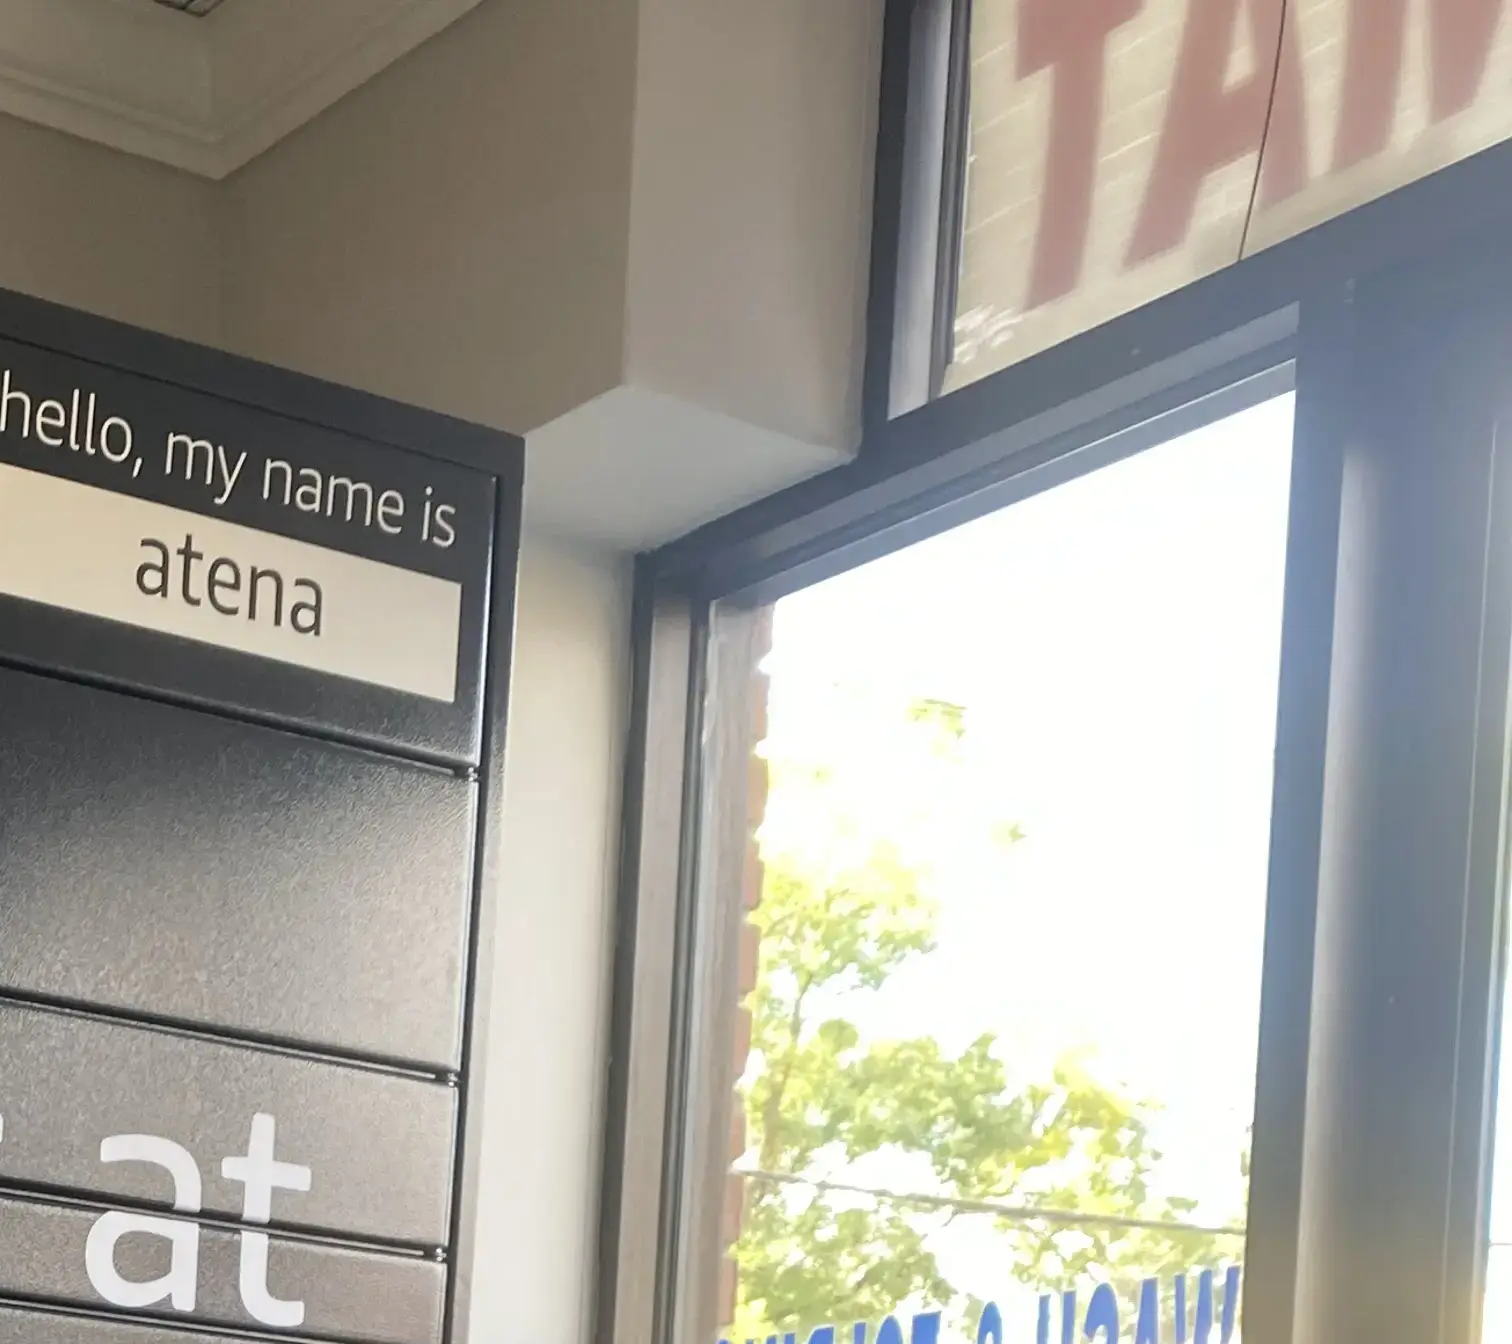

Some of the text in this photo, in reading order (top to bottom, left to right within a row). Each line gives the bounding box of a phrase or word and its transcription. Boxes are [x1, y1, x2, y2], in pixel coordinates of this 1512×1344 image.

[0, 369, 457, 548] hello, my name is
[136, 532, 324, 637] atena
[85, 1111, 314, 1327] at
